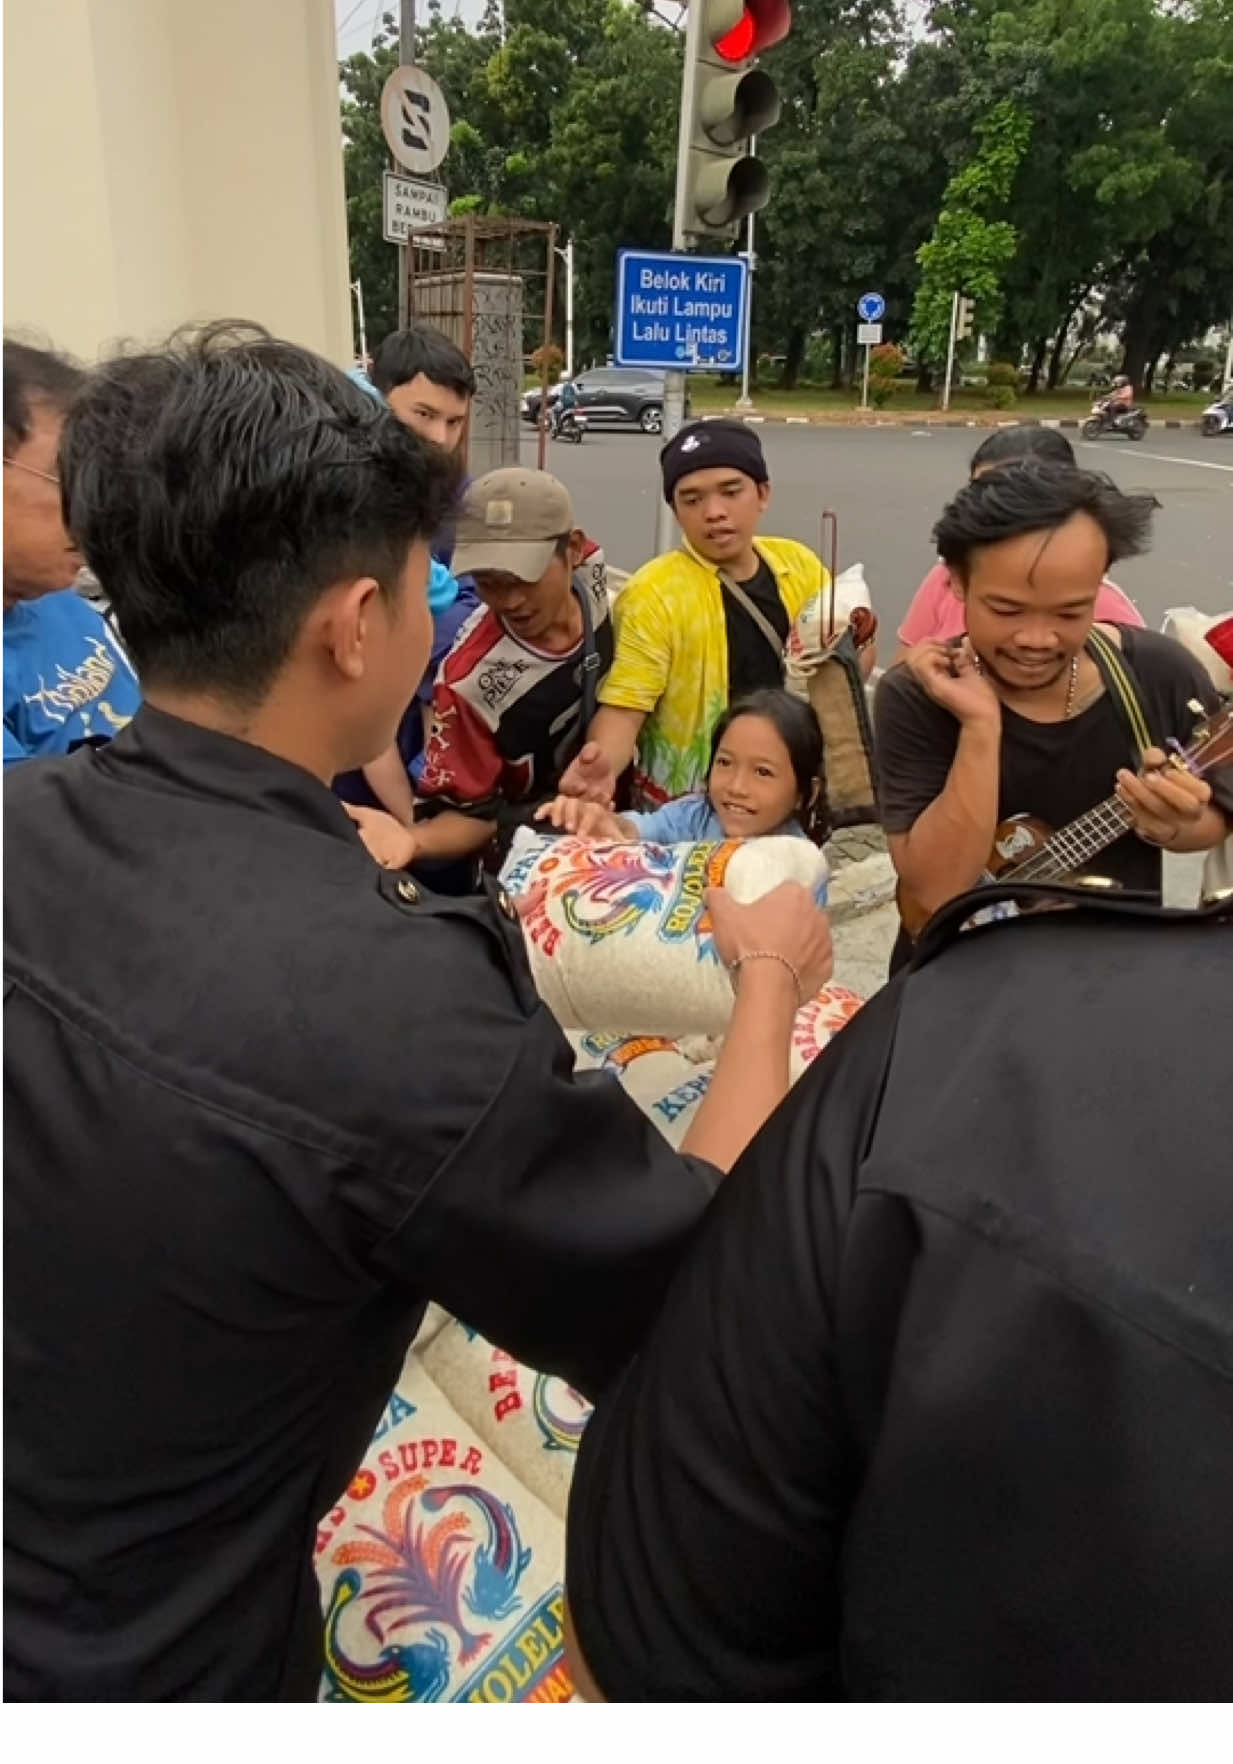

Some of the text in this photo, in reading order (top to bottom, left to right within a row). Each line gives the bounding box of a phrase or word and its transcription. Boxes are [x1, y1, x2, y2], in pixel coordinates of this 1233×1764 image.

[395, 203, 436, 222] RAMBU
[640, 269, 726, 293] Belok Kiri
[630, 294, 733, 322] Ikuti Lampu
[632, 320, 728, 344] Lalu Lintas
[377, 1438, 482, 1481] SUPER
